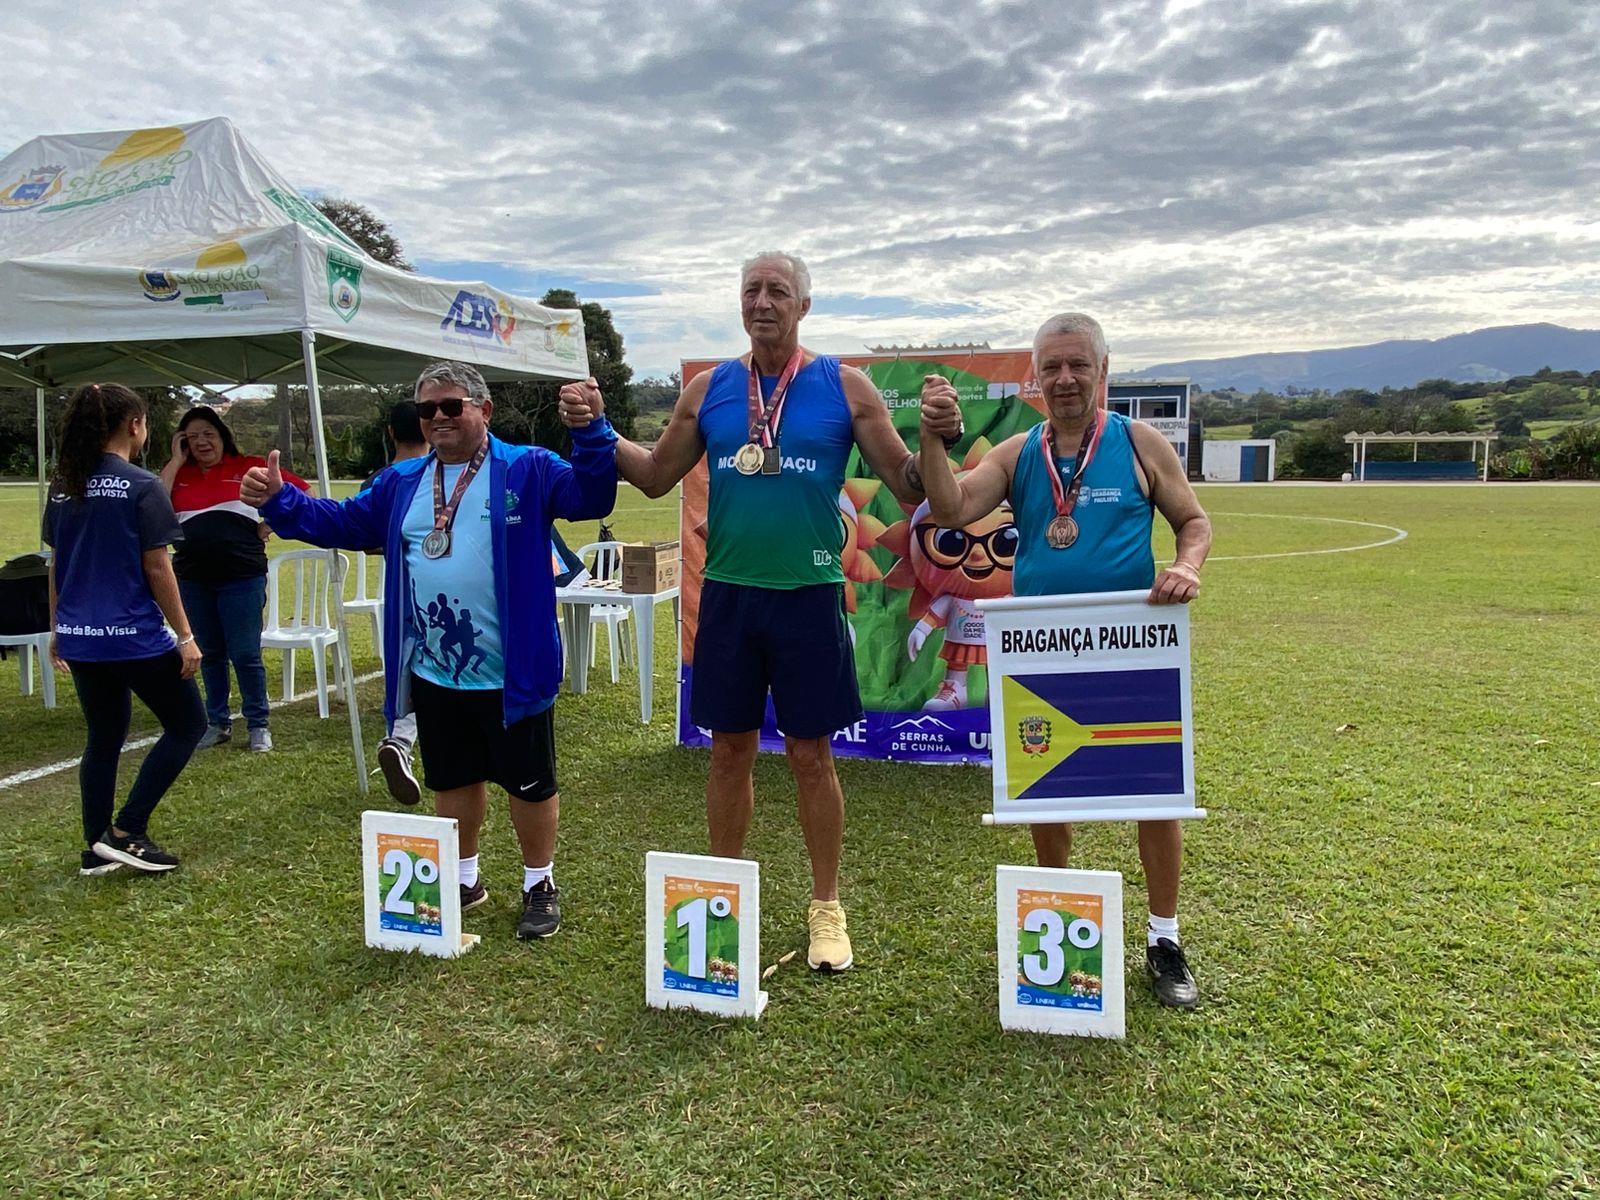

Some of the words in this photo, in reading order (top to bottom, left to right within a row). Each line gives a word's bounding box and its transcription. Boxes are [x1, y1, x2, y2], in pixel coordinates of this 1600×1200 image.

[97, 476, 131, 489] JOÃO
[101, 488, 129, 499] VISTA
[813, 550, 832, 566] DC
[72, 624, 84, 636] da
[84, 625, 104, 637] Boa
[105, 625, 138, 636] Vista
[1001, 626, 1094, 657] BRAGANÇA
[1099, 623, 1179, 650] PAULISTA
[899, 731, 944, 742] SERRAS
[892, 742, 907, 751] DE
[911, 743, 952, 753] CUNHA
